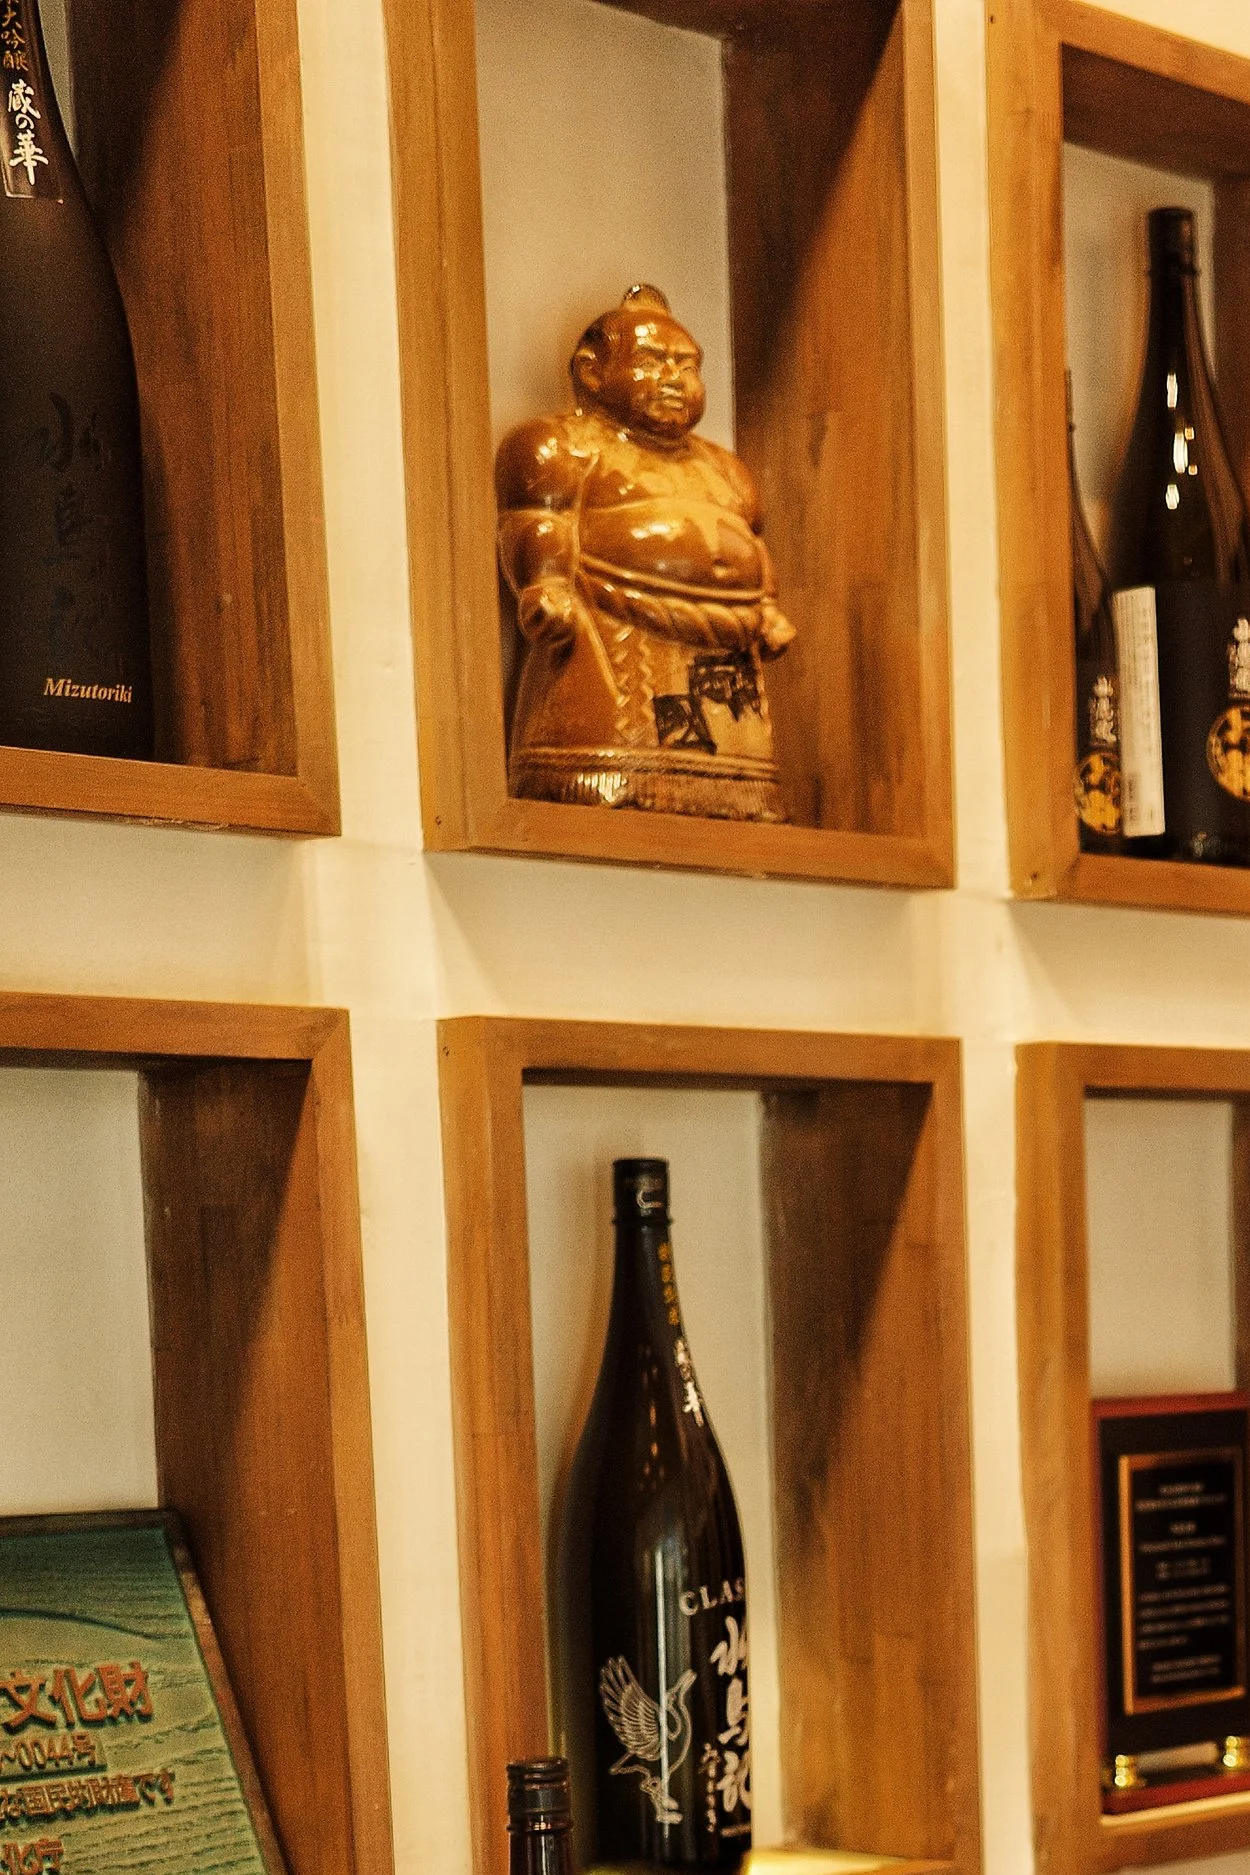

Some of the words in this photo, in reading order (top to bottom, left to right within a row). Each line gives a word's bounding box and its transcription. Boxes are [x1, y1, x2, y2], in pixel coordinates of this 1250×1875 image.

[1, 0, 28, 71] 大吟醸
[8, 78, 49, 186] 蔵の華
[44, 677, 133, 703] Mizutoriki
[1, 1661, 154, 1733] 文化財
